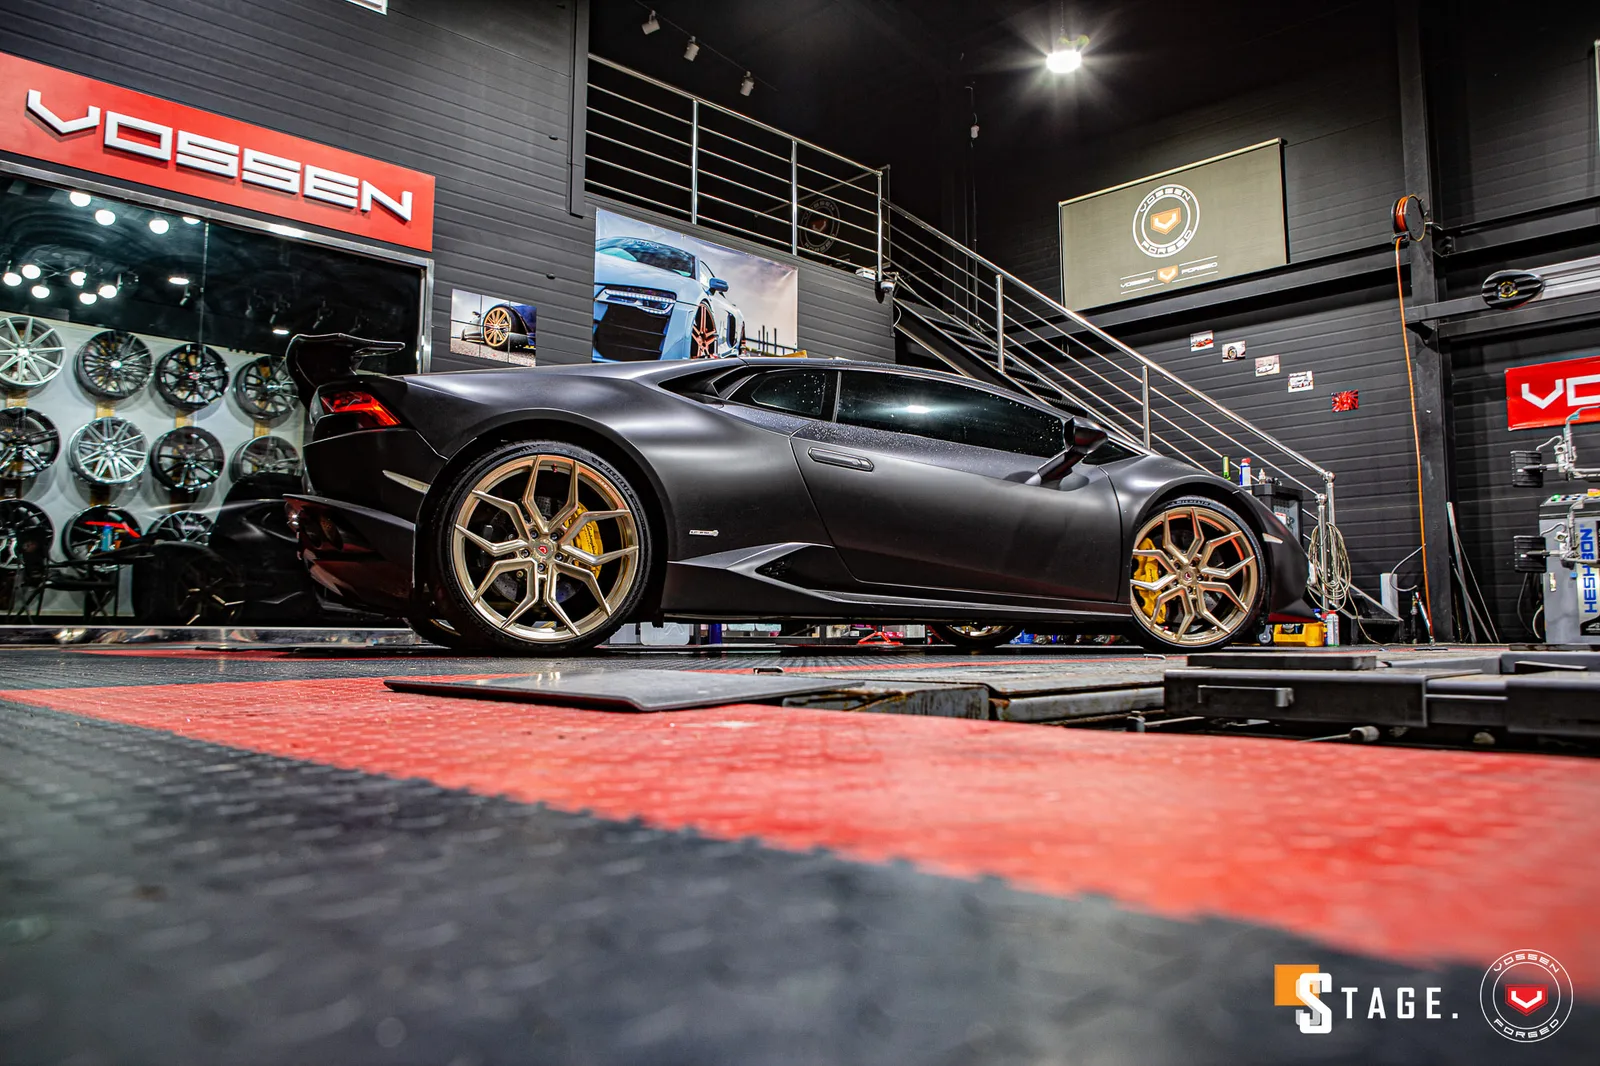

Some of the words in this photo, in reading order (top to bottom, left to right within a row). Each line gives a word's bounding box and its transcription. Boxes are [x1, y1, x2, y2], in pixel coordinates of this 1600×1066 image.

[27, 89, 413, 222] VOSSEN
[1139, 187, 1191, 213] VOSSEN
[1580, 527, 1598, 614] HESHBON
